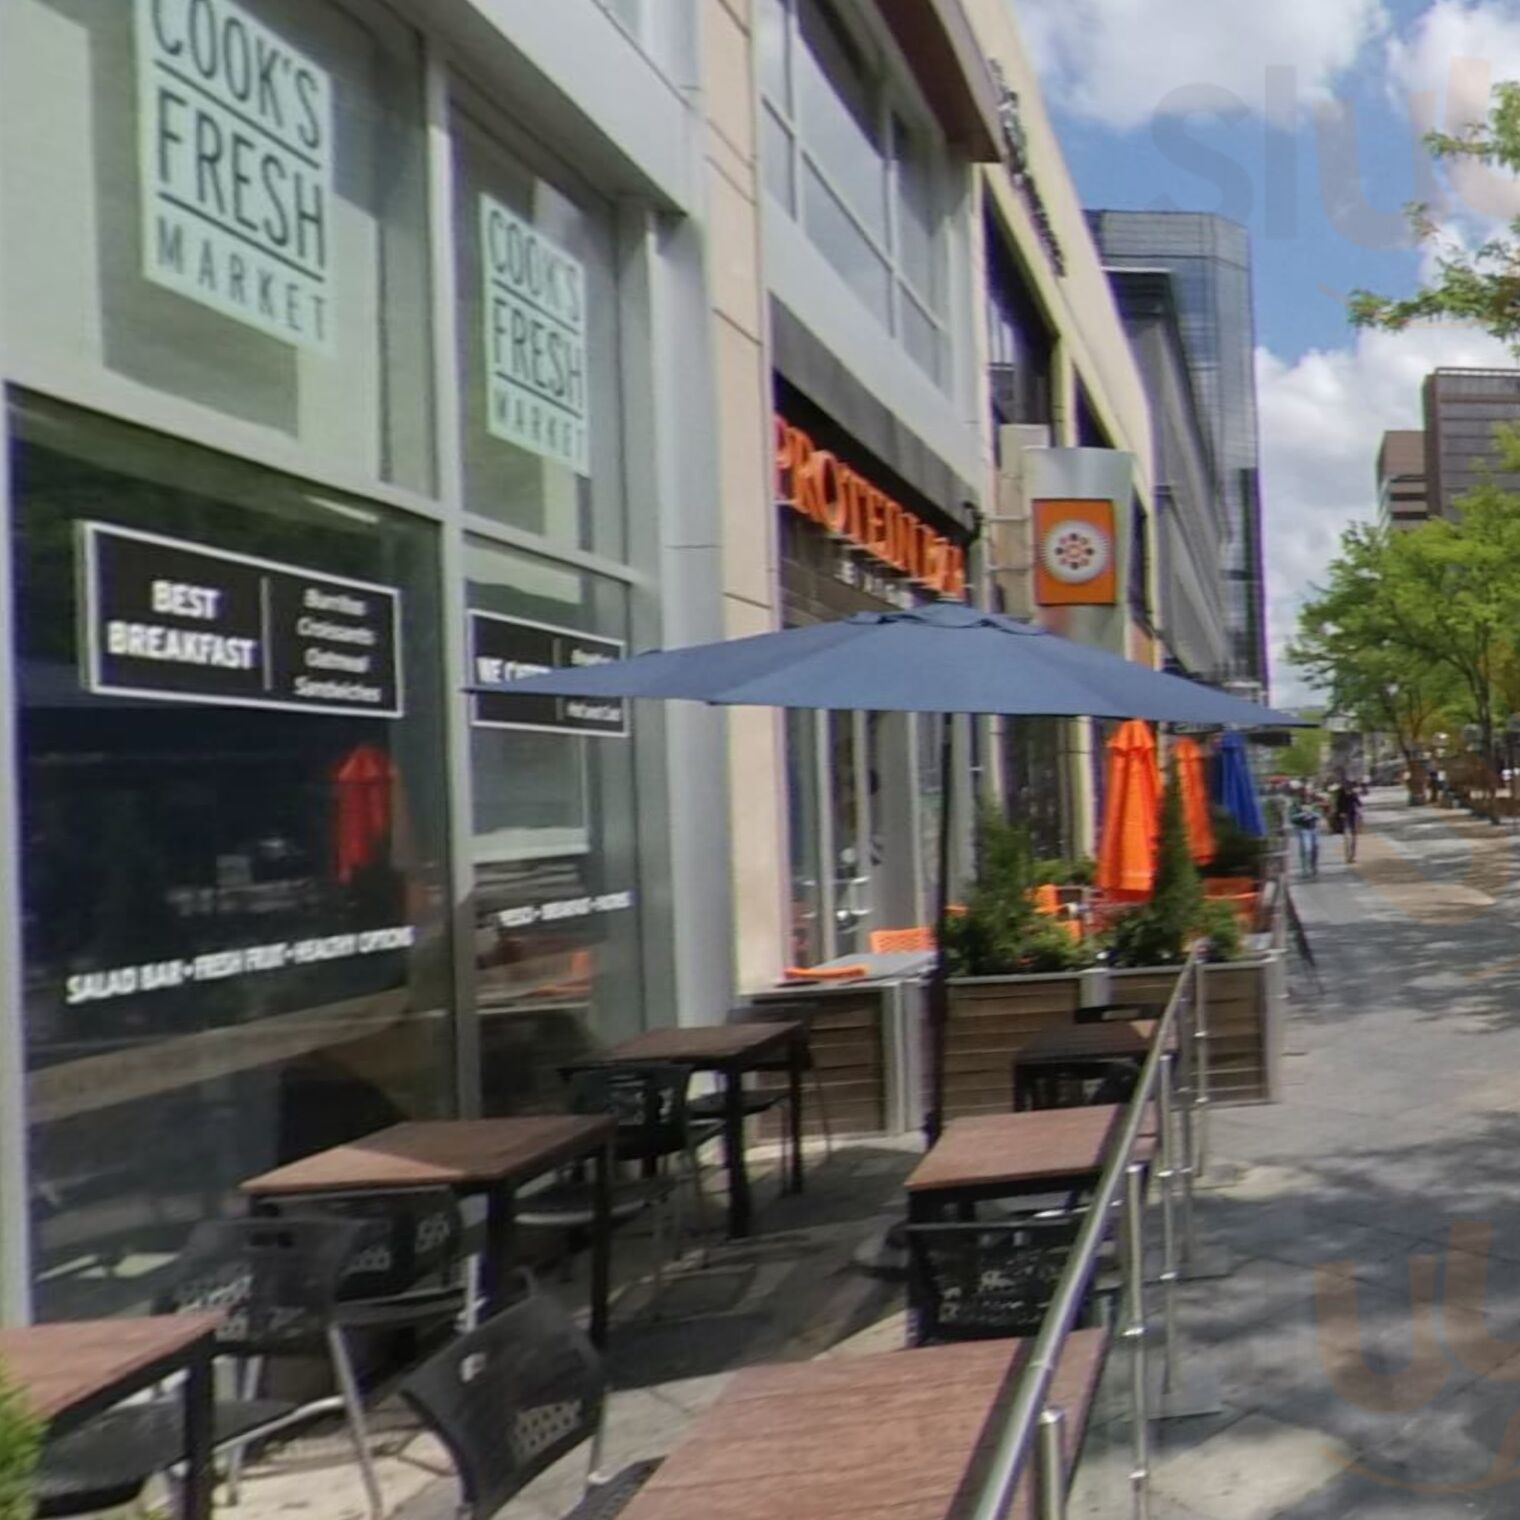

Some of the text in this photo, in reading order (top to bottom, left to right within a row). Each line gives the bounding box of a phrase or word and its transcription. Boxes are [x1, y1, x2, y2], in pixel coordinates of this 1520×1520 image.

[152, 0, 320, 149] COOK'S
[156, 85, 326, 269] FRESH
[156, 212, 328, 342] MARKET
[493, 297, 583, 410] FRESH
[494, 386, 583, 463] MARKET
[107, 620, 257, 671] BREAKFAST
[152, 578, 221, 620] BEST
[66, 966, 137, 1004] SALAD
[140, 959, 184, 991] BAR
[193, 950, 242, 981] FRESH
[245, 943, 288, 972] FRUIT
[295, 933, 356, 964] HEALTHY
